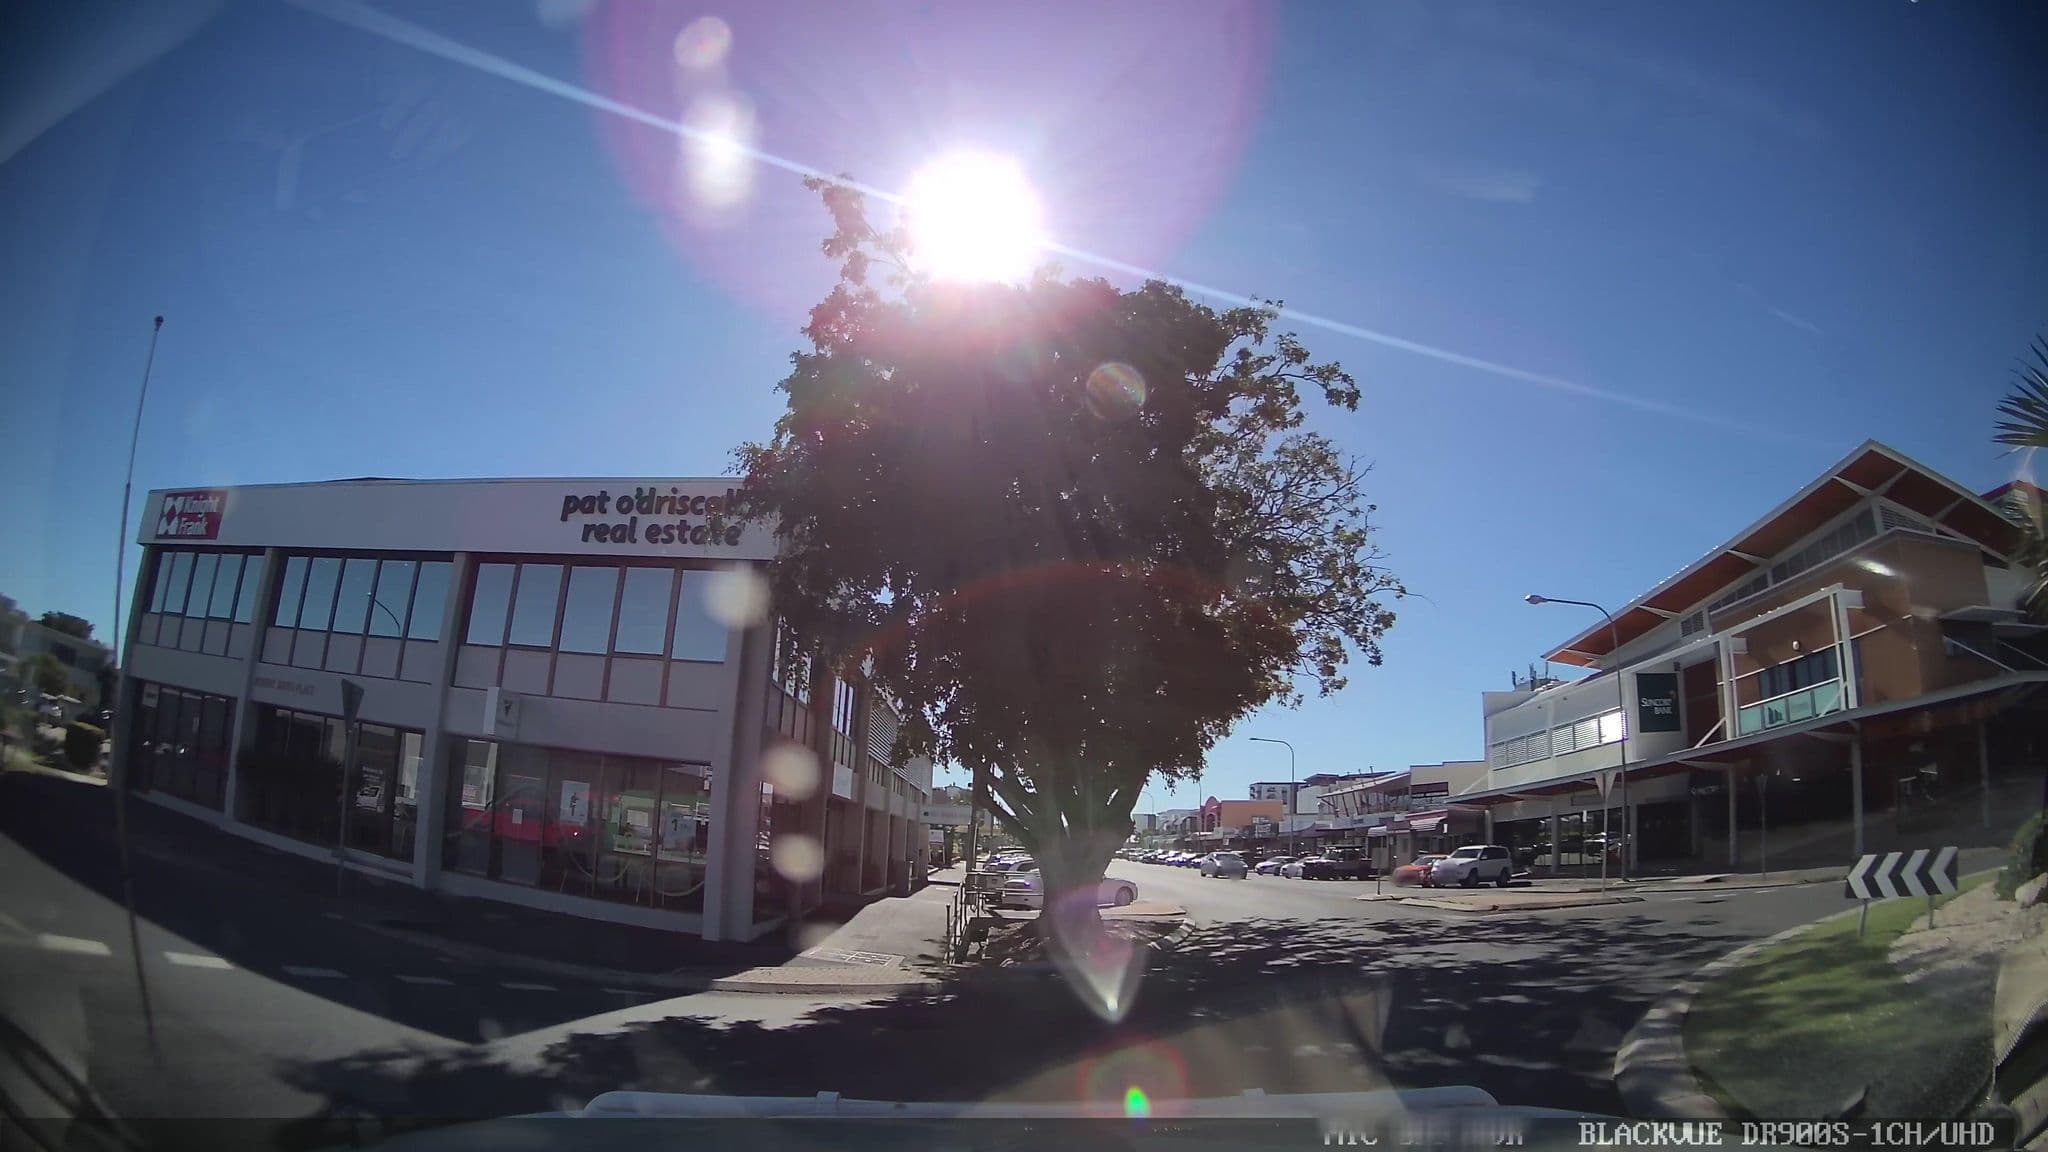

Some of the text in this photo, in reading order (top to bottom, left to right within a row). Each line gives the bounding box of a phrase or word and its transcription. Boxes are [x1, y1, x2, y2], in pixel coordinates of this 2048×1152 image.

[184, 495, 220, 518] Knight
[560, 490, 610, 521] pat
[178, 516, 209, 536] Frank
[581, 516, 637, 544] real
